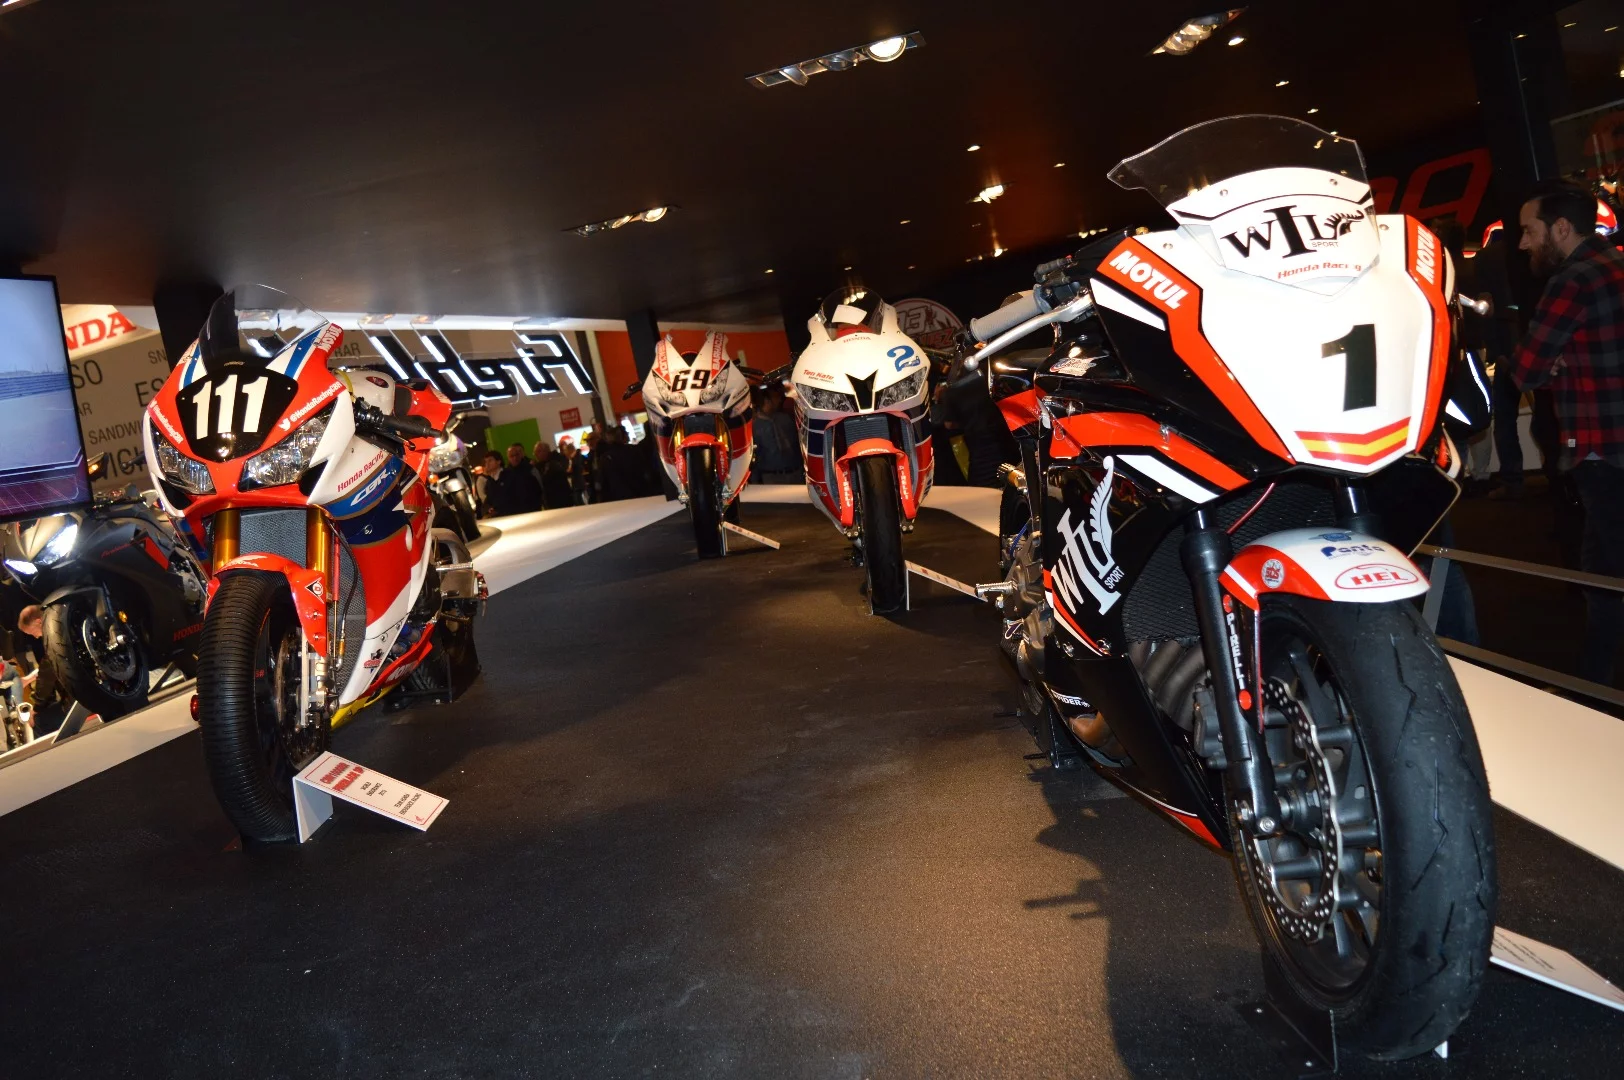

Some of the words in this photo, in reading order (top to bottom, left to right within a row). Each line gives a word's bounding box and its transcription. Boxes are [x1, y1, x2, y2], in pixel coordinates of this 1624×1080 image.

[1277, 264, 1320, 280] Honda
[1415, 225, 1435, 286] MOTUL
[1108, 250, 1189, 310] MOTUL
[843, 336, 871, 344] HONDA
[887, 345, 921, 372] 2
[671, 369, 711, 393] 69
[1321, 323, 1378, 413] 1
[192, 374, 269, 440] 111
[289, 381, 343, 423] @HondaRacingCBR
[337, 470, 363, 493] Honda
[363, 450, 385, 473] Racing
[350, 468, 391, 507] CBR
[1103, 565, 1126, 590] SPORT
[1351, 571, 1409, 586] HEL
[1226, 612, 1246, 690] PIRELLI
